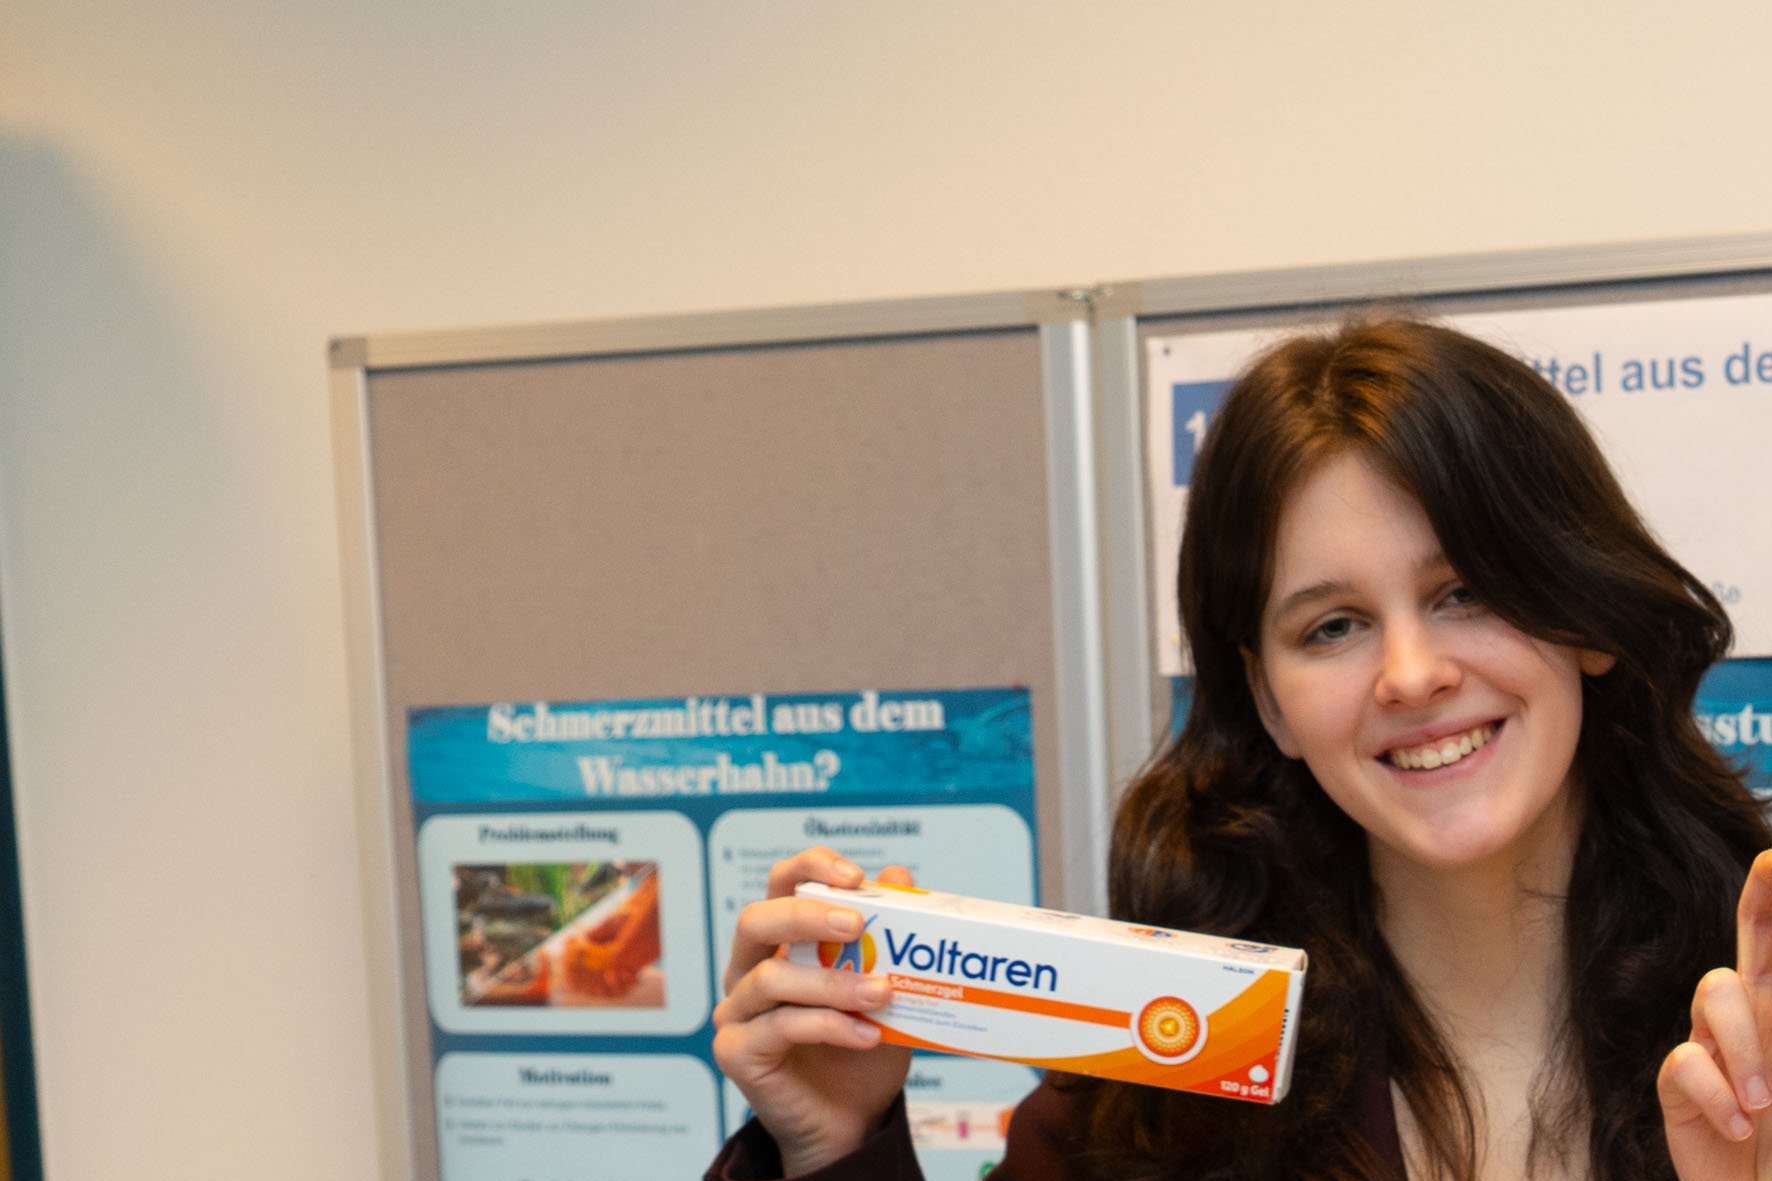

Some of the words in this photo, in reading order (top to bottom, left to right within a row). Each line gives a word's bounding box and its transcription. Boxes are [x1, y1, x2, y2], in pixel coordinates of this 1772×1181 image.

[1621, 355, 1705, 392] aus
[487, 692, 768, 743] Schmerzmittel
[772, 702, 844, 735] aus
[850, 690, 946, 733] dem
[578, 750, 842, 797] Wasserhahn?
[884, 927, 1058, 992] Voltaren
[890, 975, 965, 1000] Schmerzgel
[1220, 1079, 1240, 1093] 120
[1240, 1085, 1250, 1097] g
[1250, 1084, 1270, 1097] Gel
